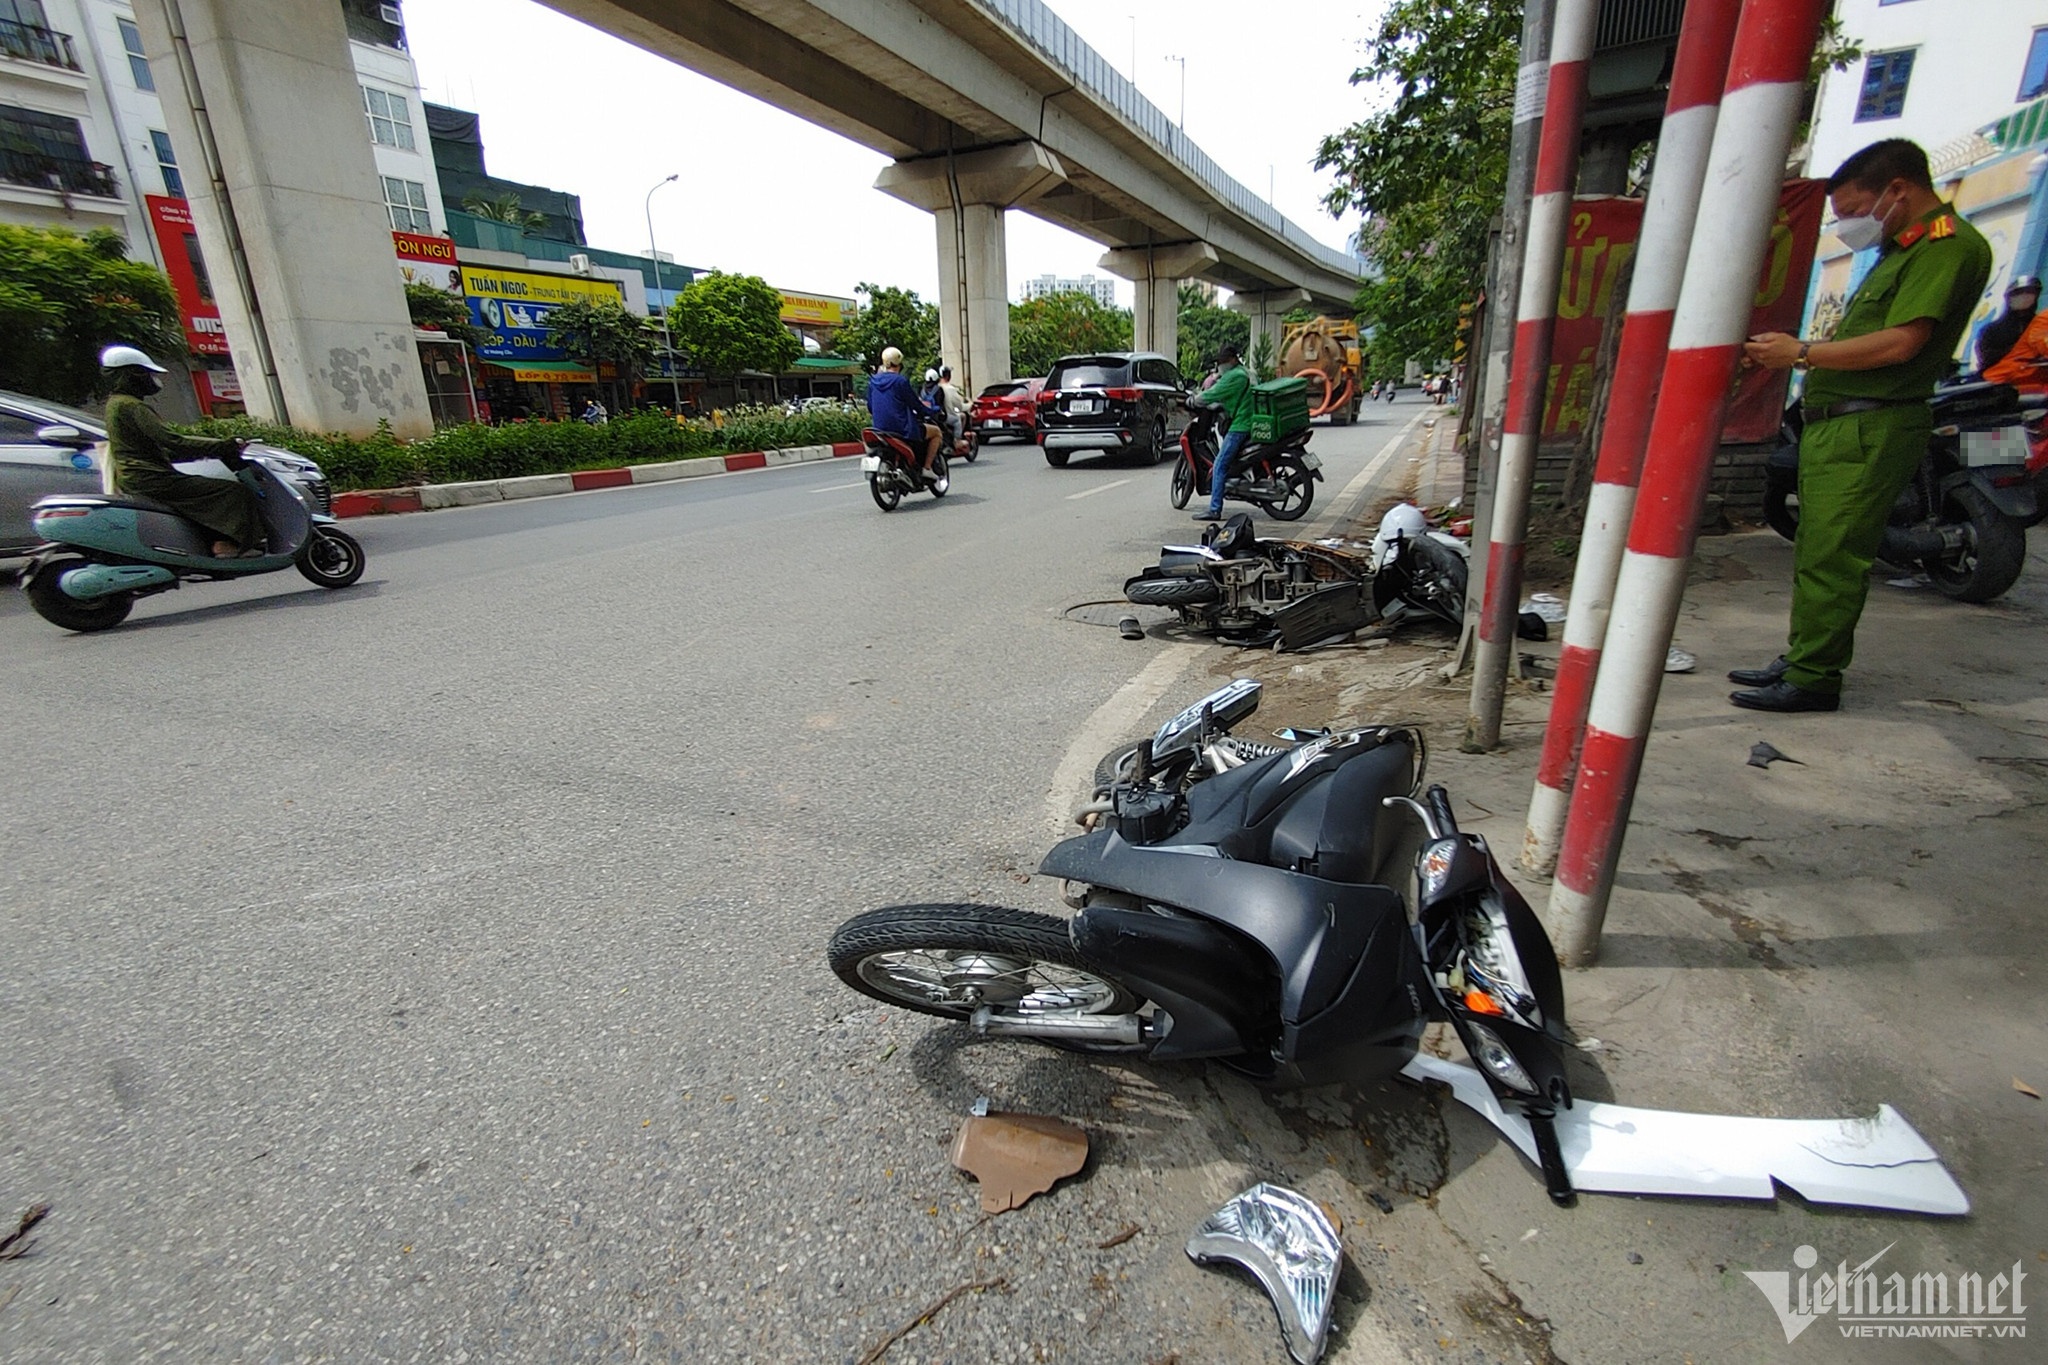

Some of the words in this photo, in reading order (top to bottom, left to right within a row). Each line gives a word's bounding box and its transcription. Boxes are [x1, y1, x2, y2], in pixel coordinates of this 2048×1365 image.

[469, 273, 499, 293] TUẤN
[500, 280, 529, 298] NGỌC
[513, 332, 537, 348] DẦU
